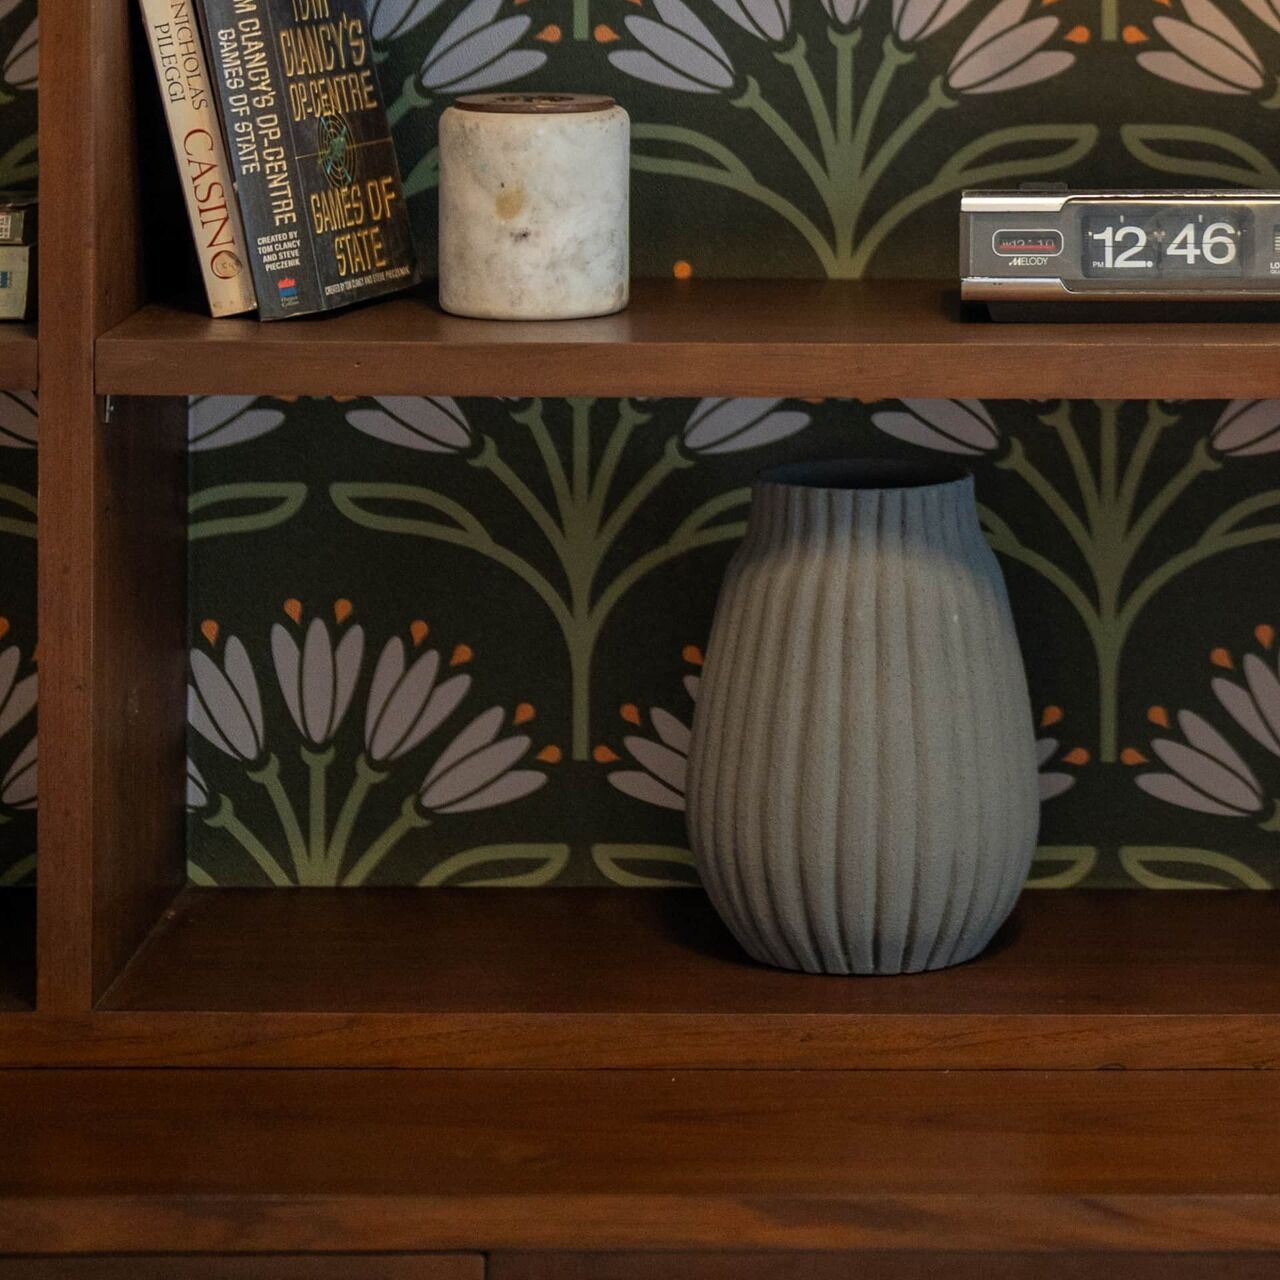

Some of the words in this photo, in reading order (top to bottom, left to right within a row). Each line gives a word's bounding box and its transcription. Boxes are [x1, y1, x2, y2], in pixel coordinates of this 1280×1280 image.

[155, 22, 186, 104] PILEGGI
[170, 0, 208, 112] NICHOLAS
[217, 28, 245, 90] GAMES
[238, 17, 277, 110] CLANCY'S
[279, 11, 366, 78] CLANCY'S
[228, 93, 250, 118] OF
[289, 69, 378, 122] OP-CENTRE
[234, 121, 261, 176] STATE
[256, 114, 297, 227] OP-CENTRE
[183, 127, 242, 281] CASINO
[310, 184, 364, 235] GAMES
[367, 175, 396, 221] OF
[256, 232, 288, 246] CREATED
[288, 230, 299, 240] BY
[257, 243, 274, 255] TOM
[274, 240, 301, 251] CLANCY
[262, 253, 278, 264] AND
[278, 249, 300, 260] STEVE
[265, 258, 301, 272] PIECZENIK
[334, 226, 387, 277] STATE
[1008, 256, 1048, 266] MELODY
[1093, 226, 1147, 268] 12
[1166, 222, 1236, 265] 46
